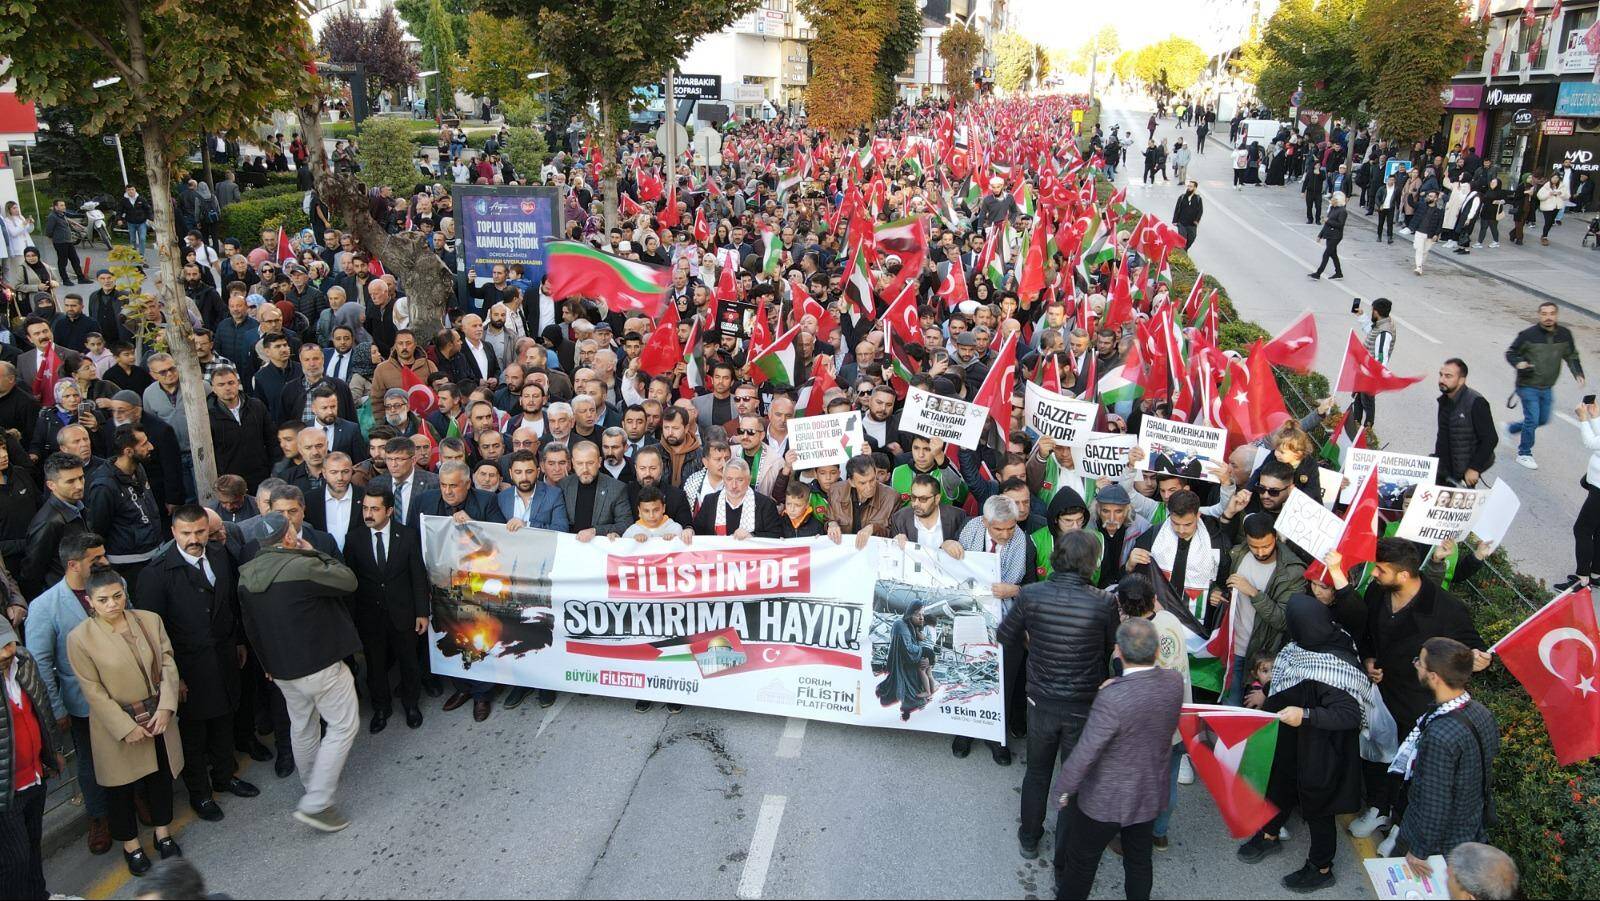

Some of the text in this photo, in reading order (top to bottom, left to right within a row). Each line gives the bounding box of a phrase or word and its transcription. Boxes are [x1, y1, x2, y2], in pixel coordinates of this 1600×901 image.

[673, 76, 716, 86] DİYARBAKIR
[674, 86, 702, 95] SOFRASI
[1502, 93, 1532, 104] PARFUMEUR
[1564, 149, 1593, 164] MAD
[476, 220, 537, 238] TOPLU ULAŞIMI
[475, 235, 540, 252] KAMULAŞTIRDIK
[920, 409, 967, 427] NETANYAHU
[1037, 401, 1075, 426] GAZZE
[1032, 412, 1076, 441] ÖLÜYOR!
[796, 440, 824, 451] DEVLETE
[1085, 444, 1120, 461] GAZZE
[1082, 457, 1126, 477] ÖLÜYOR
[1427, 508, 1472, 522] NETANYAHU
[617, 554, 800, 594] FİLİSTİN'DE
[563, 600, 863, 650] SOYKIRIMA HAYIR!
[565, 668, 699, 694] BÜYÜK FİLİSTİN YÜRÜYÜŞÜ
[797, 686, 854, 703] FİLİSTİN
[796, 699, 854, 713] PLATFORMU
[939, 706, 952, 714] 19
[954, 706, 977, 718] Ekim
